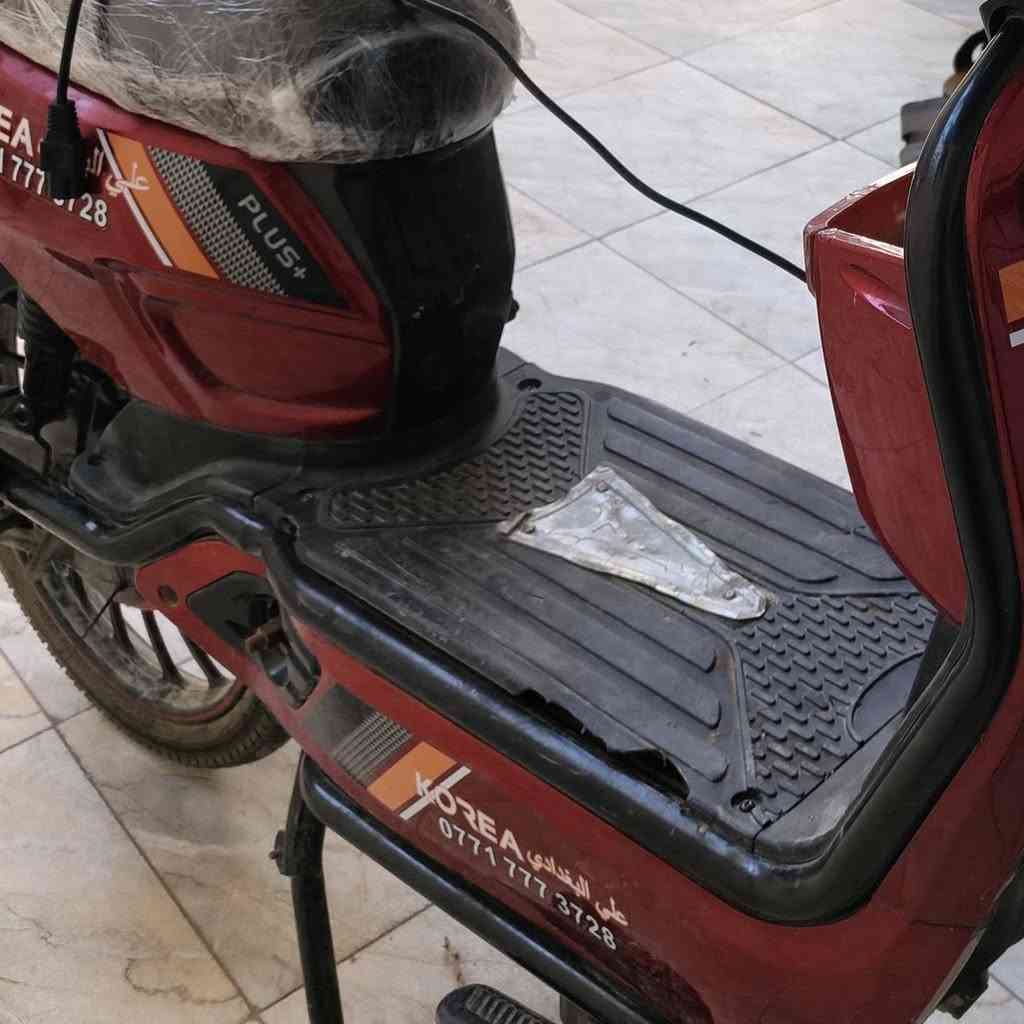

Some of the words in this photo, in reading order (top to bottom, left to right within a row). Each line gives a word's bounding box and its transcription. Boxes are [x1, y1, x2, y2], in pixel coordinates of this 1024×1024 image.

[237, 193, 307, 280] PLUS+
[415, 772, 526, 863] KOREA
[439, 817, 497, 867] 0771
[503, 856, 547, 898] 777
[554, 892, 617, 951] 3728
